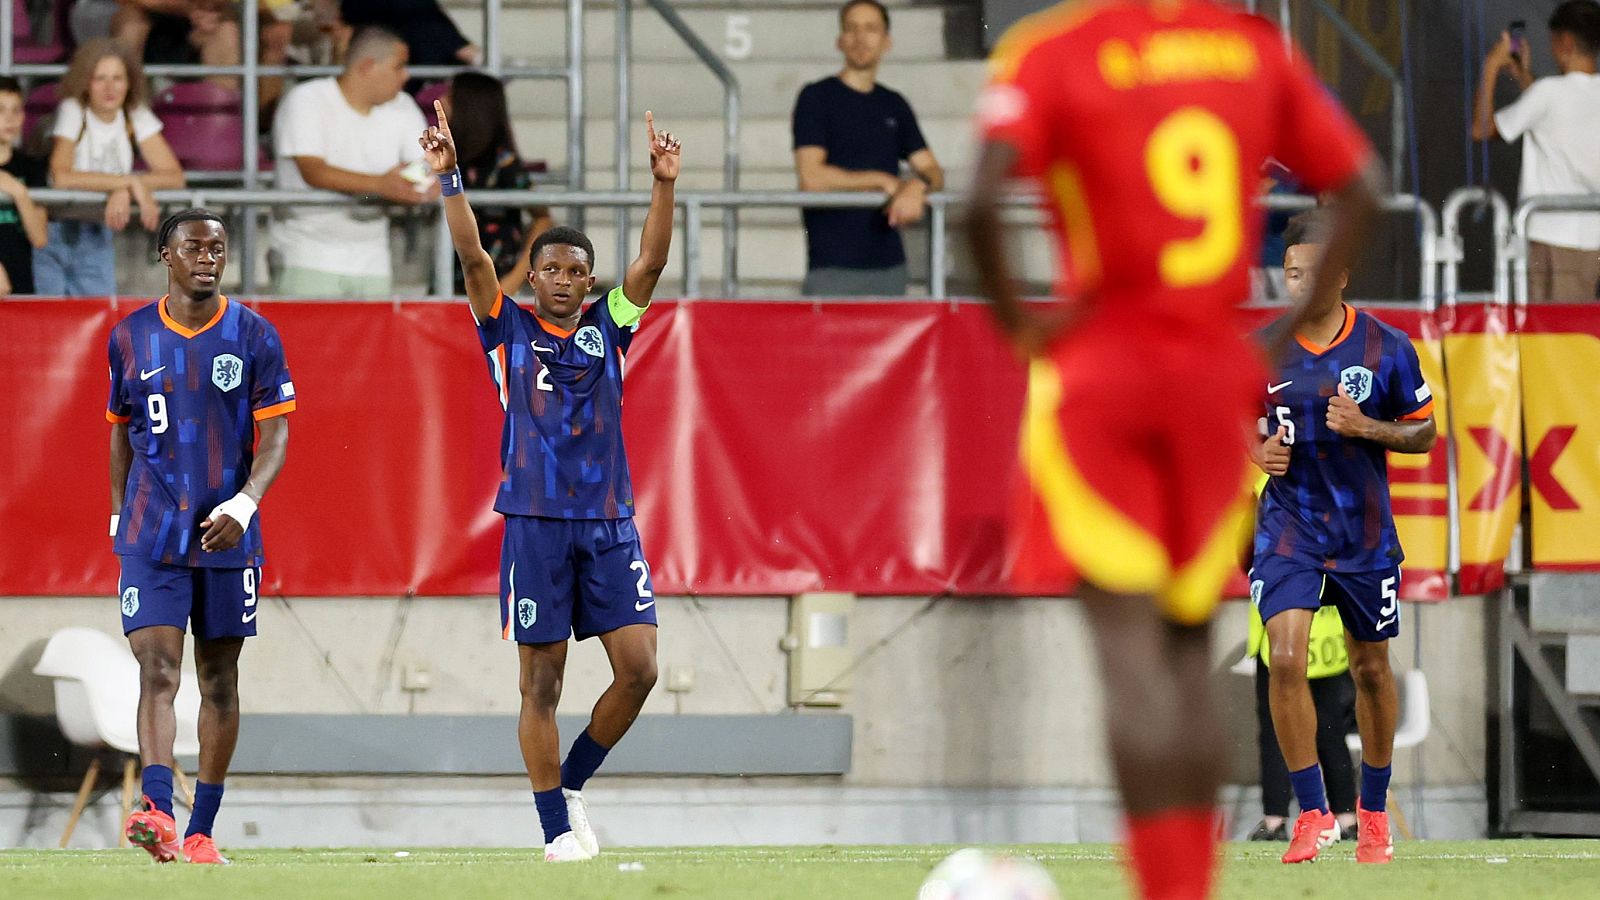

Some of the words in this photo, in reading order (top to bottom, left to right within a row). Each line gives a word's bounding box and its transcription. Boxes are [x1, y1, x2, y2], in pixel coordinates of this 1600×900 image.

[726, 15, 752, 57] 5
[1145, 105, 1241, 287] 9
[148, 393, 169, 434] 9
[1276, 406, 1295, 444] 5
[243, 568, 257, 607] 9
[629, 560, 653, 597] 2
[1380, 576, 1397, 617] 5
